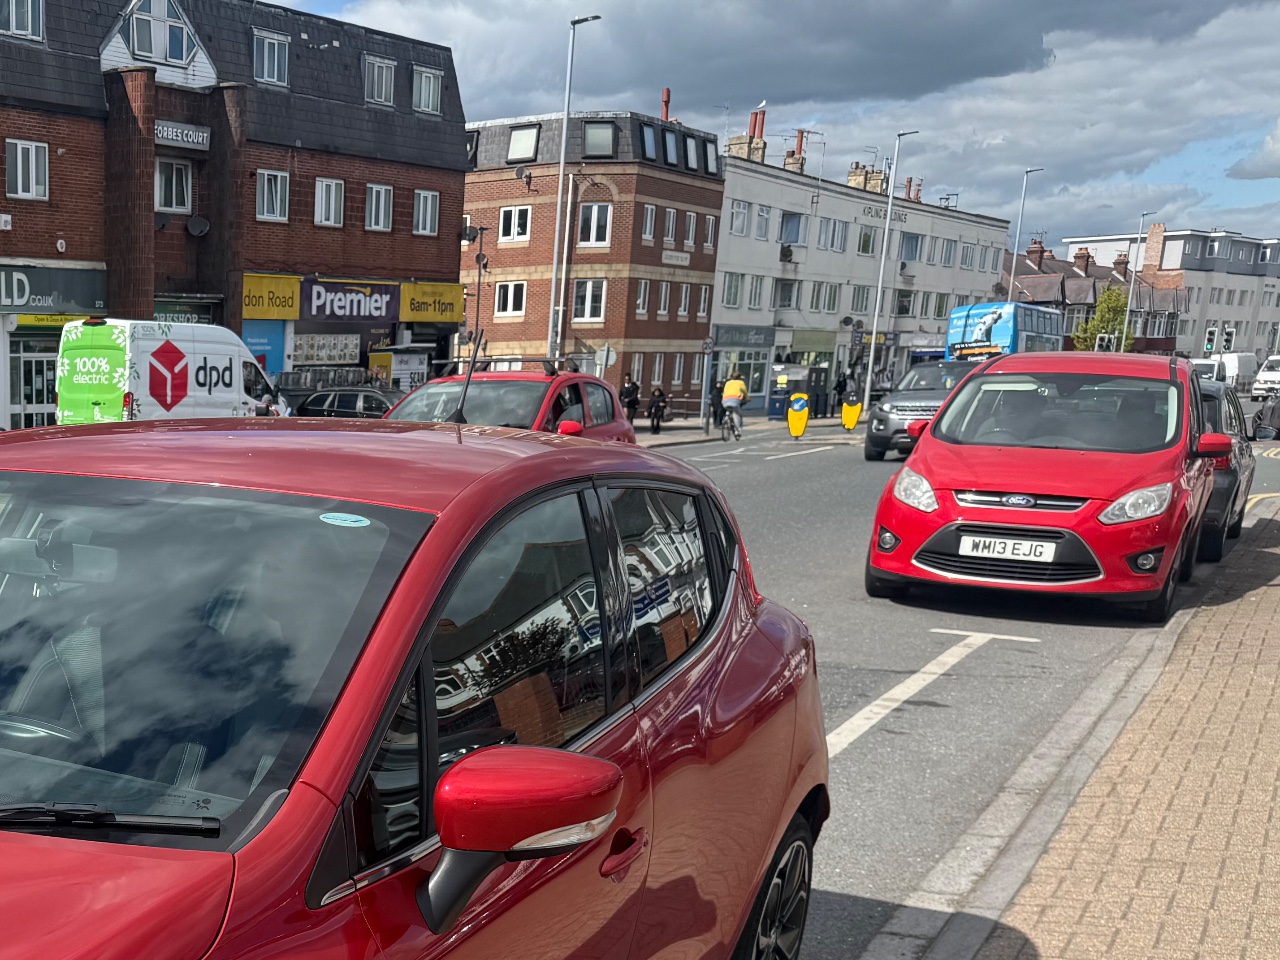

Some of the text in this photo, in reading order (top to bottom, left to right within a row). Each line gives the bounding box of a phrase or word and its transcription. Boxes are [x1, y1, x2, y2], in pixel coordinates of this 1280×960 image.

[183, 130, 208, 144] COURT
[862, 206, 908, 223] KIPLING BLDINGS
[267, 291, 295, 309] Road
[311, 284, 391, 317] Premier
[410, 297, 455, 316] 6am-11pm
[153, 312, 198, 324] ORKSHOP
[73, 356, 110, 373] 100%
[73, 372, 110, 384] electric
[195, 356, 233, 395] dpd
[970, 539, 1045, 558] WM13 EJG
